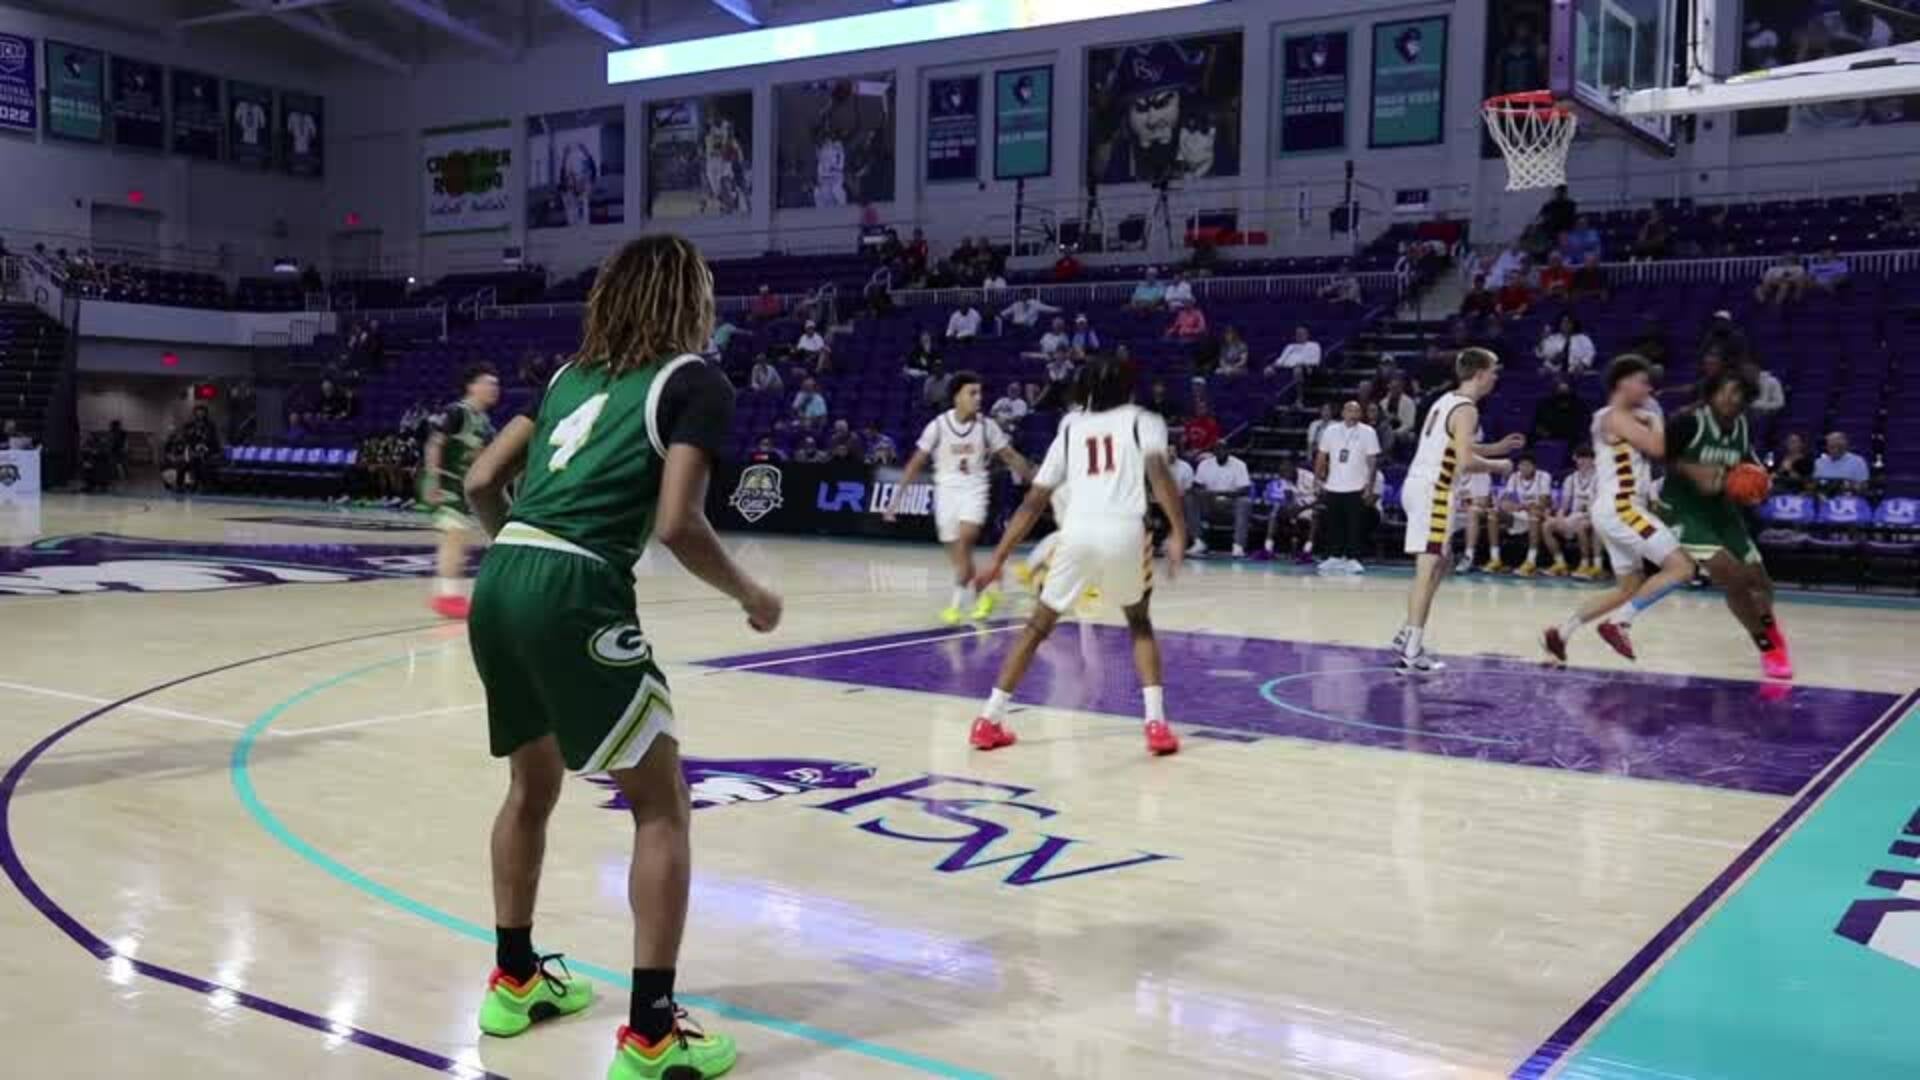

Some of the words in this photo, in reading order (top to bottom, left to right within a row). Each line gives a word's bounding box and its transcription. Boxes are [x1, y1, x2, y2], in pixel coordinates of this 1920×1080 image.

[548, 393, 608, 472] 4
[1086, 434, 1115, 475] 11
[816, 481, 866, 513] UR
[812, 774, 1183, 886] FSW
